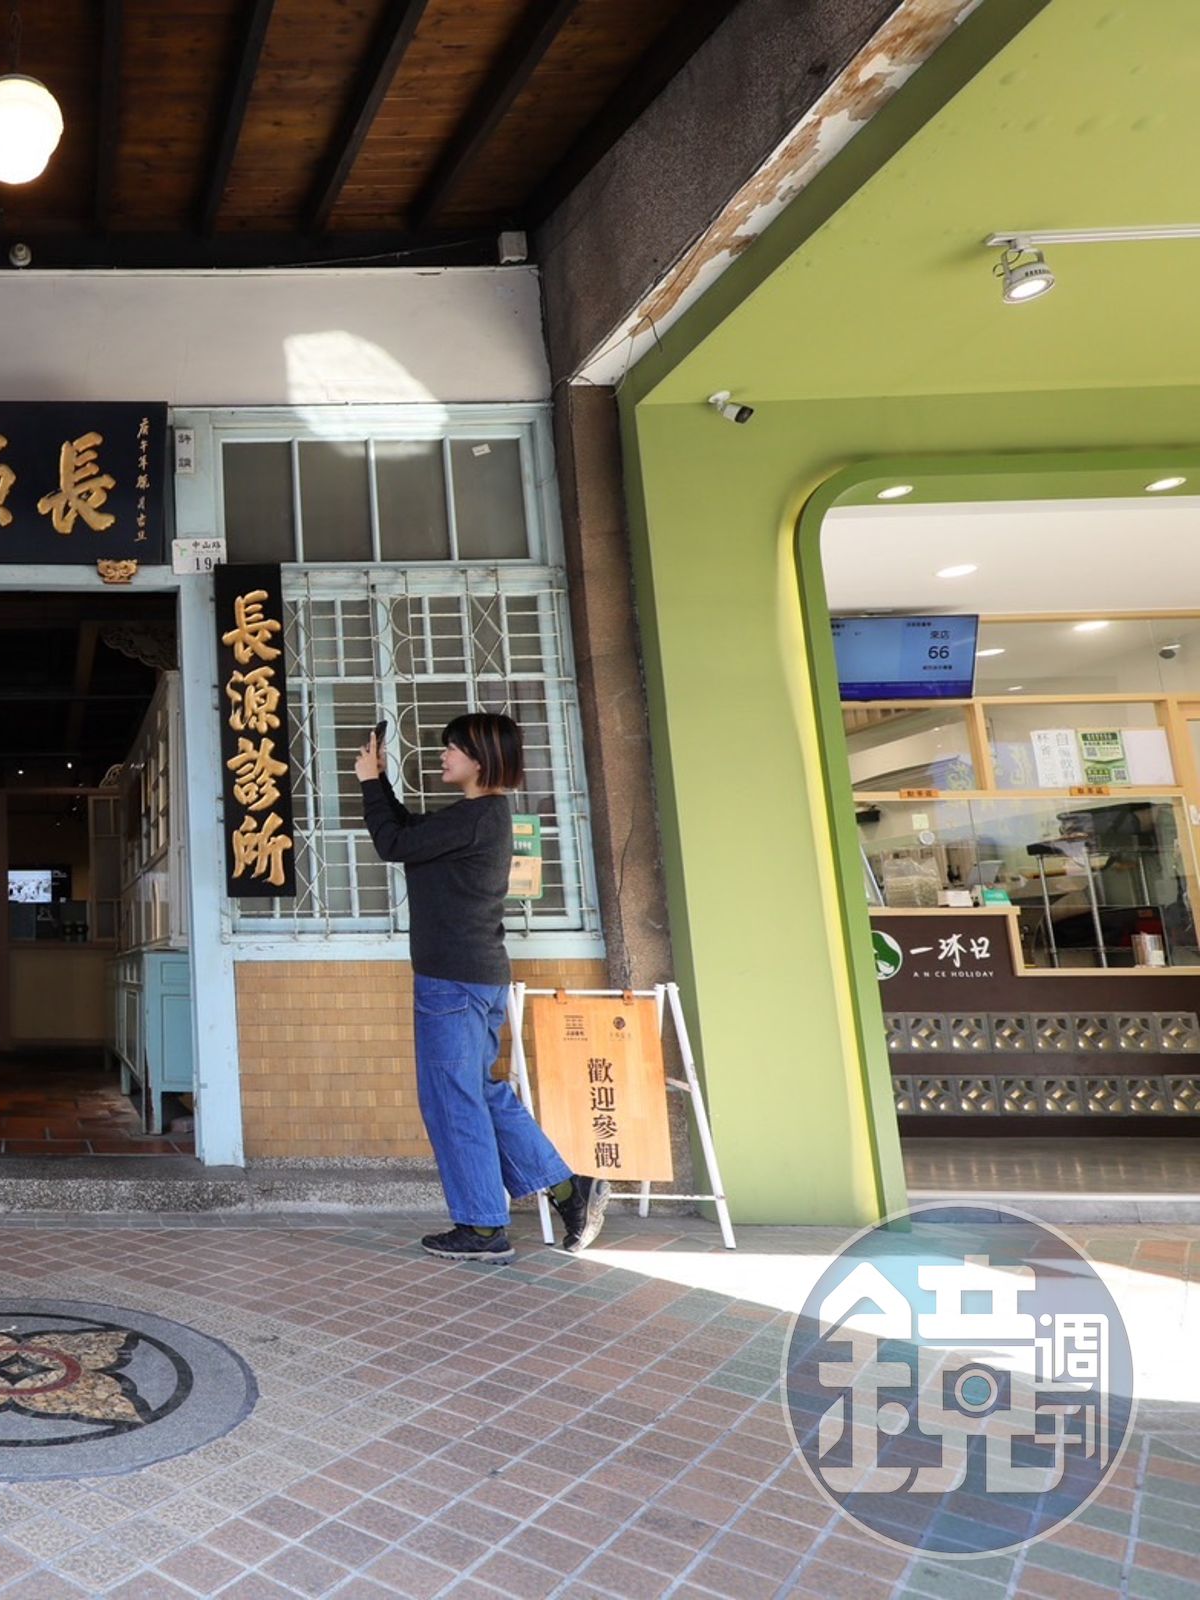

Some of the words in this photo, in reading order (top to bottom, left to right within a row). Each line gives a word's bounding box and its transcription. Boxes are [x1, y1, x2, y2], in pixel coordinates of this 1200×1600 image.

[928, 645, 950, 659] 66
[222, 589, 292, 887] 長源診所
[587, 1057, 622, 1169] 歡迎參觀
